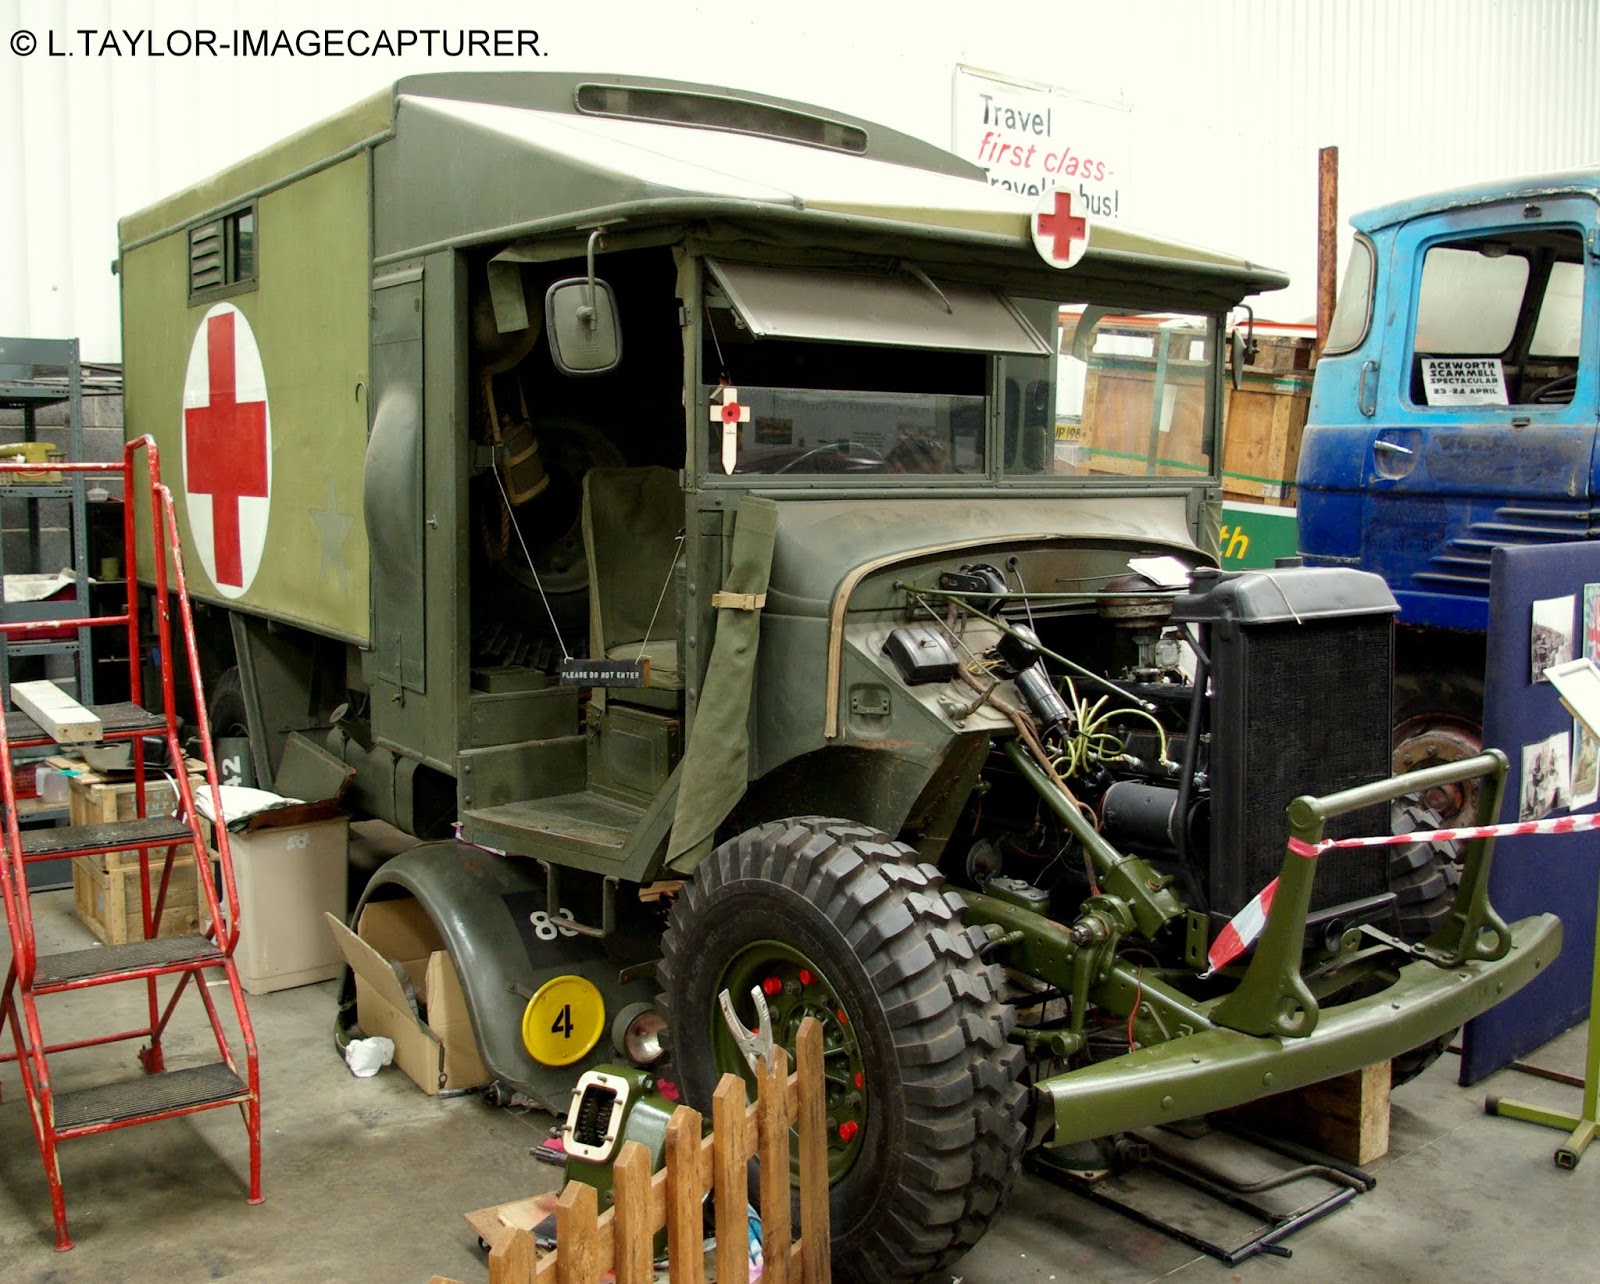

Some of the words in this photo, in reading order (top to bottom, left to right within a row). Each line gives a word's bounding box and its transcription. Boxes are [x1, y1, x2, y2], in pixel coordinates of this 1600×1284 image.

[979, 93, 1051, 137] Travel
[978, 131, 1037, 169] first
[1043, 147, 1115, 182] class-
[1079, 183, 1119, 219] bus!
[1429, 361, 1495, 369] ACKWORTH
[561, 671, 588, 679] PLEASE
[589, 671, 599, 679] DO
[600, 671, 614, 679] NOT
[616, 671, 640, 679] ENTER
[551, 1004, 574, 1039] 4
